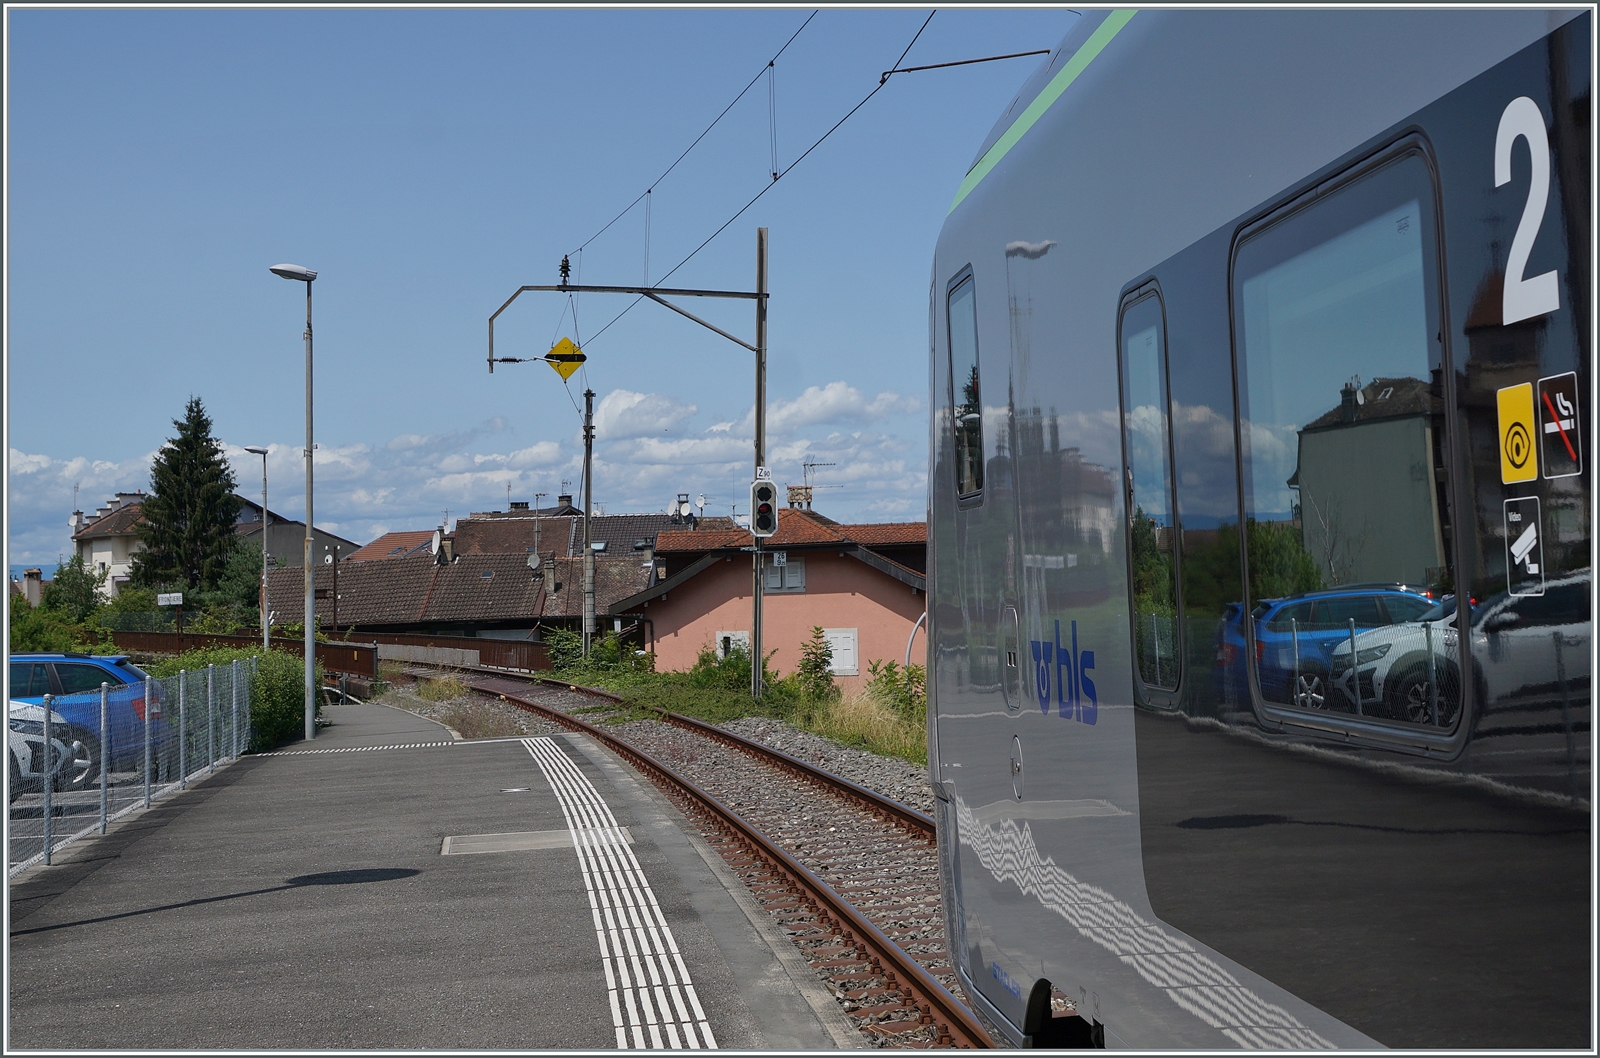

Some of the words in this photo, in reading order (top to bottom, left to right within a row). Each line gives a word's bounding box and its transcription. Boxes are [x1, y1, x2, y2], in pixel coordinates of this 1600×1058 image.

[1495, 96, 1560, 326] 2
[1508, 511, 1522, 522] Video
[1054, 619, 1098, 726] bls
[992, 962, 1022, 1002] STADLER
